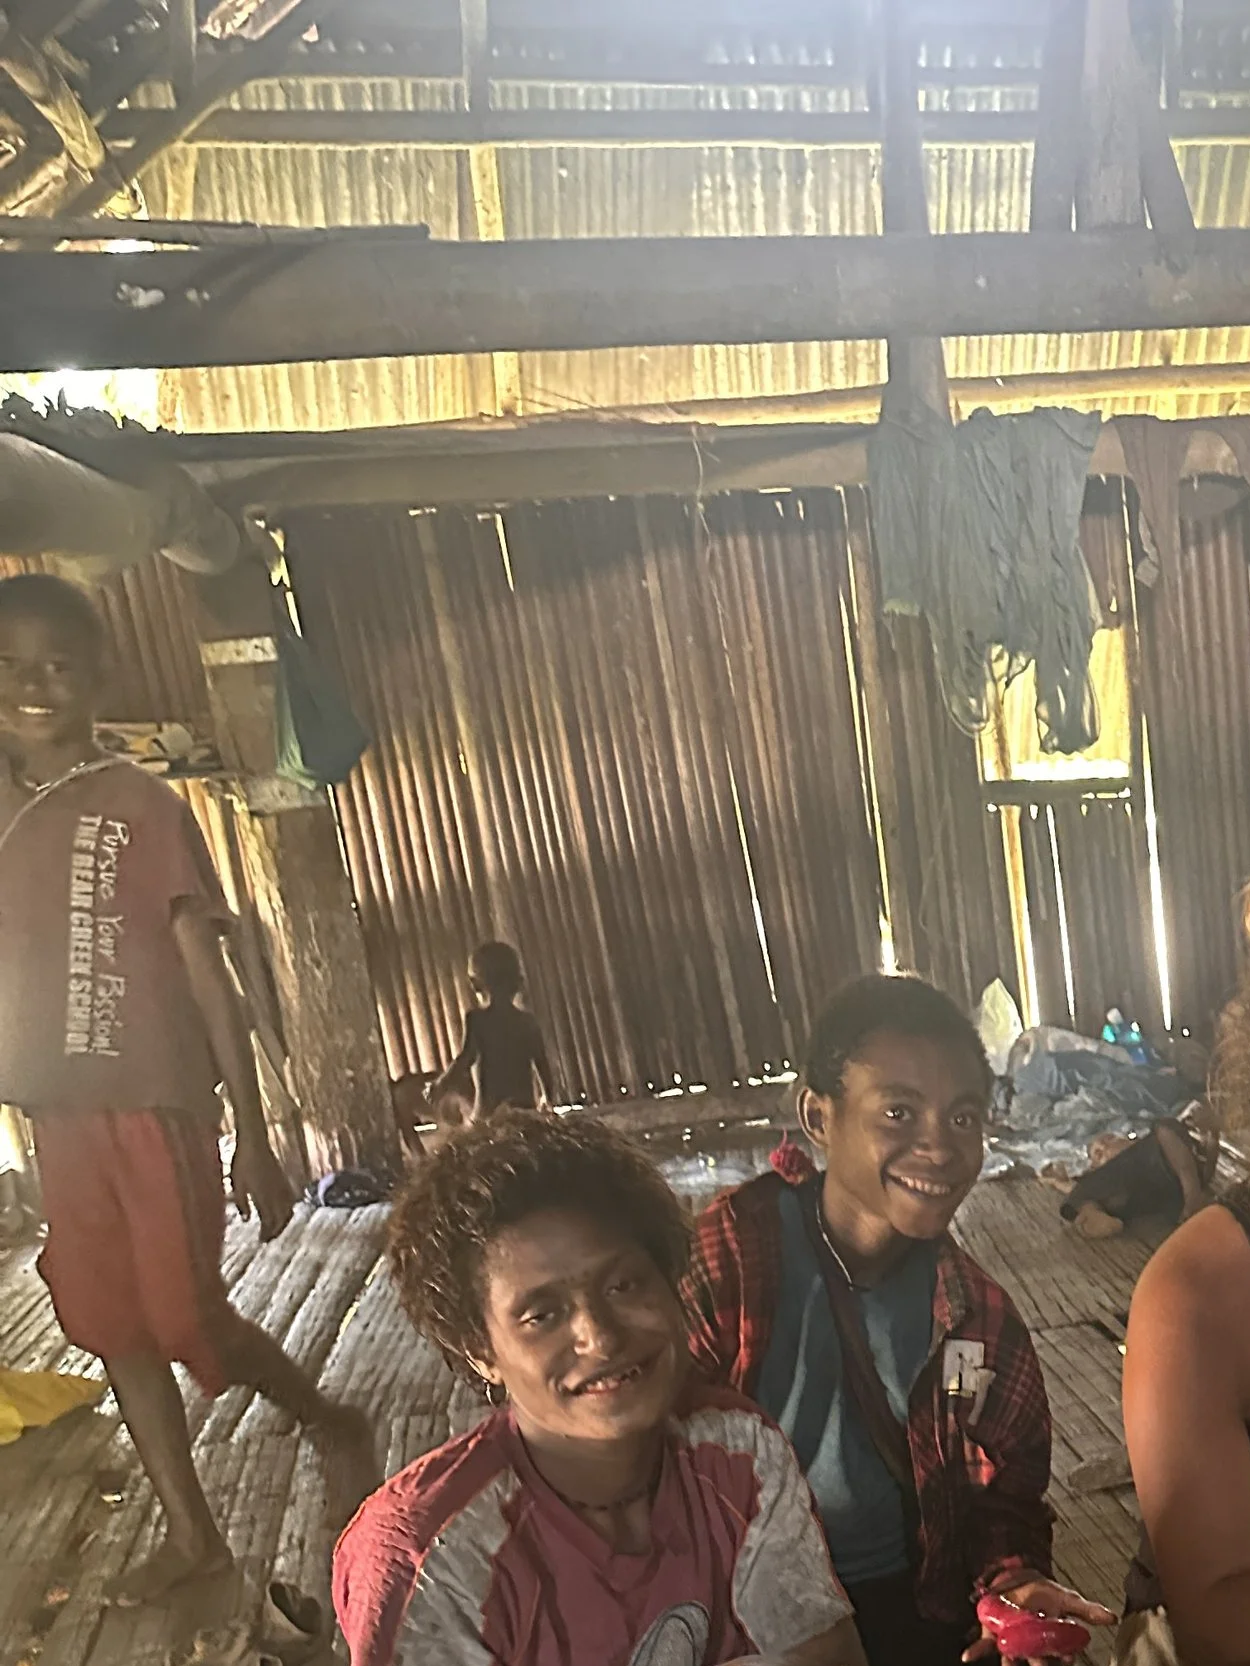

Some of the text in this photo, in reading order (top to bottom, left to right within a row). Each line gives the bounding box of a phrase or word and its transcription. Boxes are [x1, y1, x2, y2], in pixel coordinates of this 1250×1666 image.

[73, 815, 102, 850] THE
[99, 819, 131, 901] Pursue
[97, 914, 125, 966] Your
